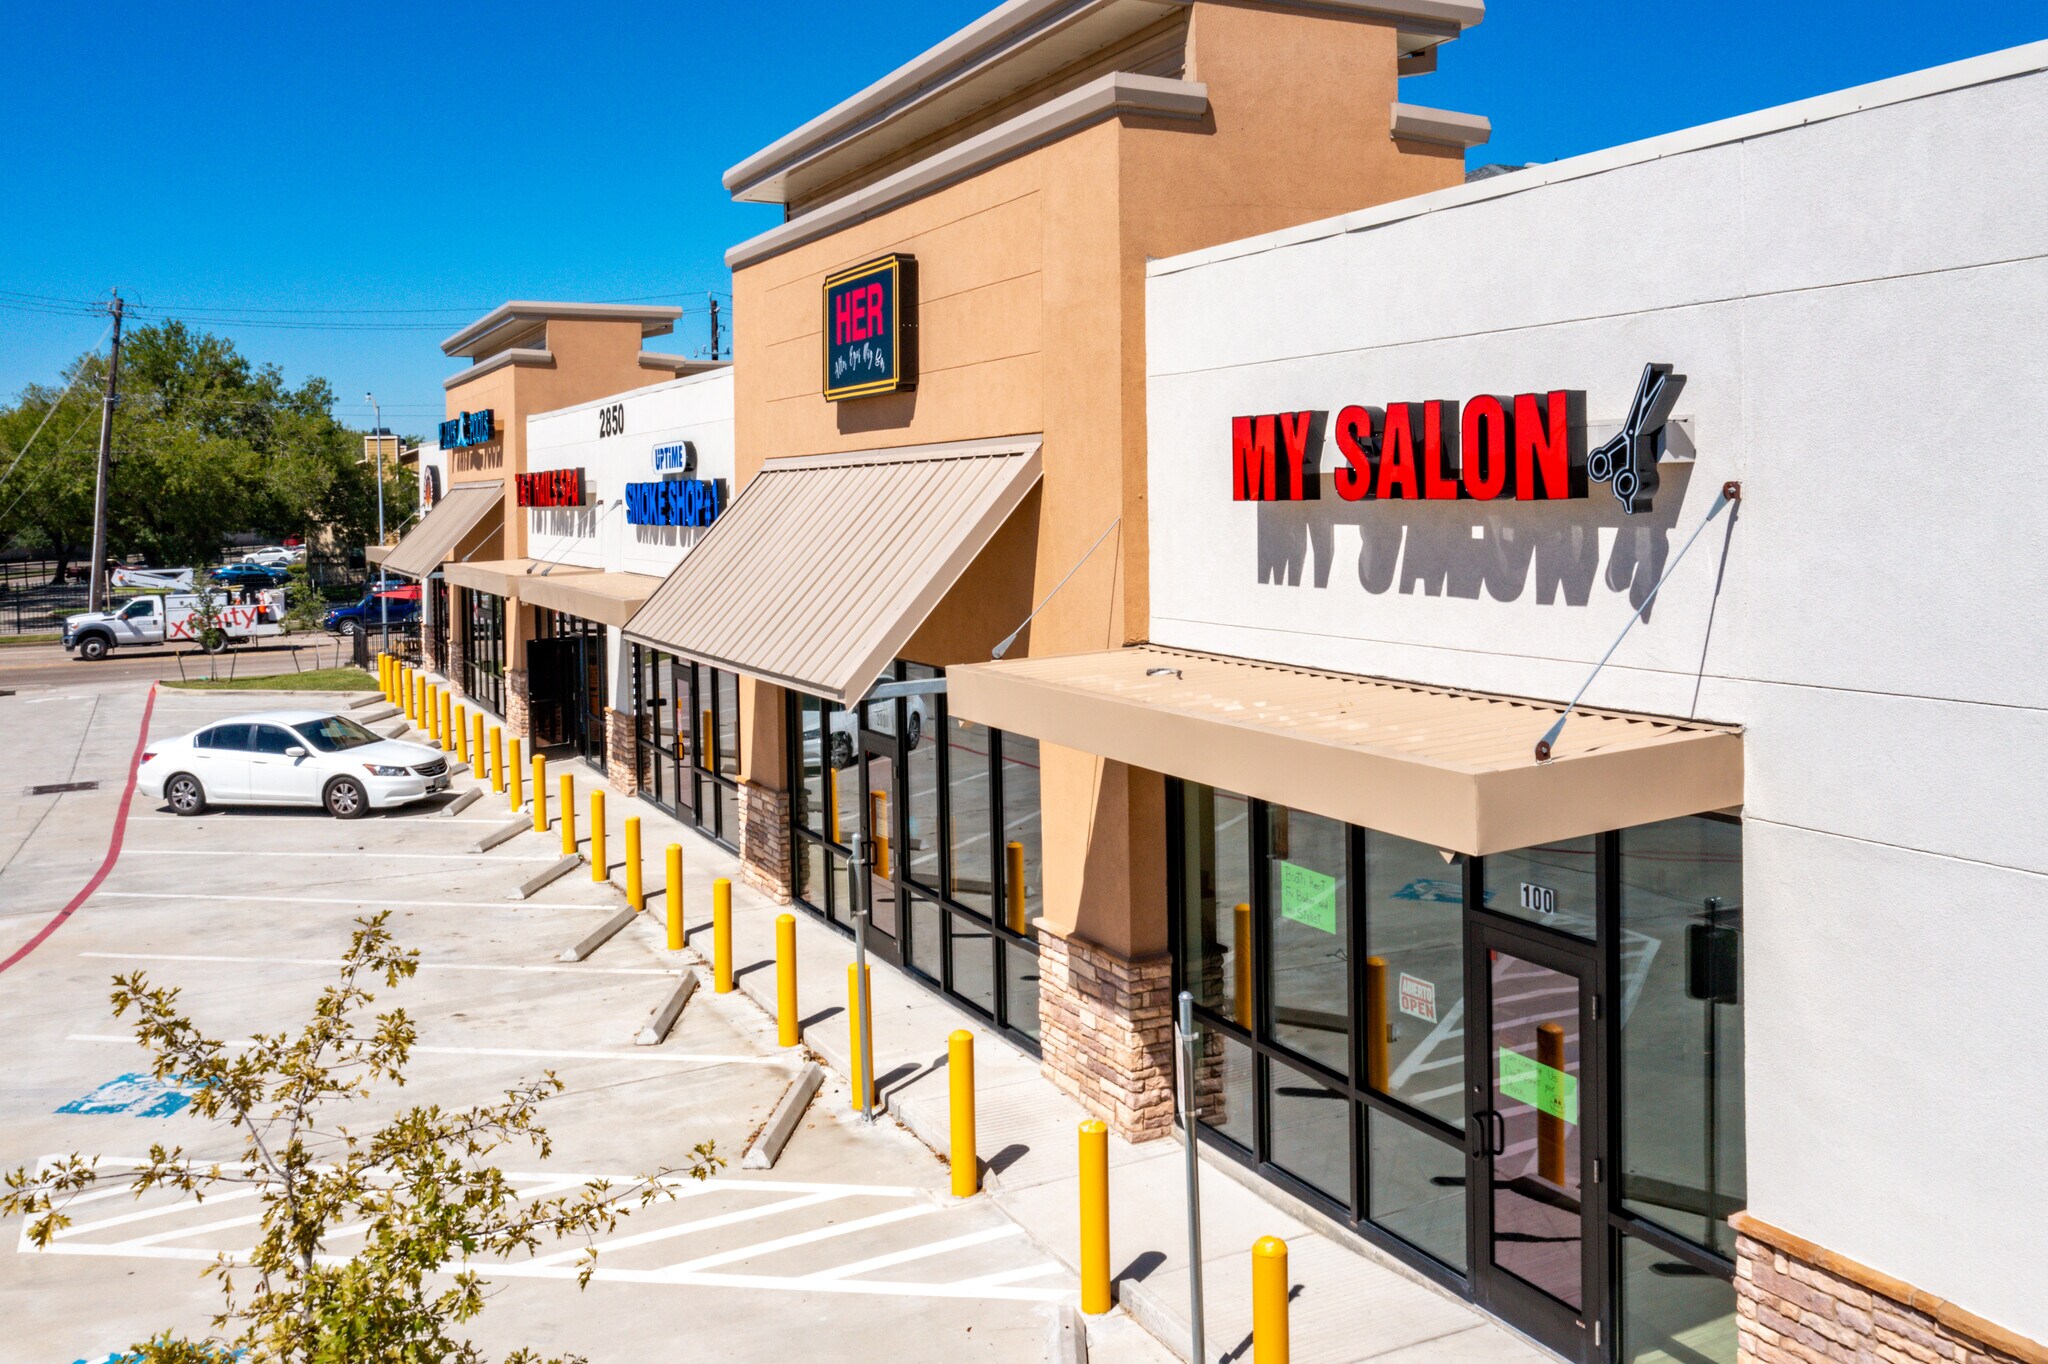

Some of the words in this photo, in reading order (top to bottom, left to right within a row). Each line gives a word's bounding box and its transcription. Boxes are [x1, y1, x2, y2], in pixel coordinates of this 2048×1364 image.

[836, 282, 884, 346] HER
[599, 403, 624, 439] 2850
[1232, 410, 1312, 501] MY
[1334, 389, 1570, 502] SALON
[560, 467, 579, 507] SPA
[625, 480, 667, 526] SMOKE
[668, 480, 704, 527] SHOP
[1523, 884, 1552, 914] 100
[1401, 995, 1435, 1019] OPEN
[1402, 978, 1434, 1003] ABIERTO
